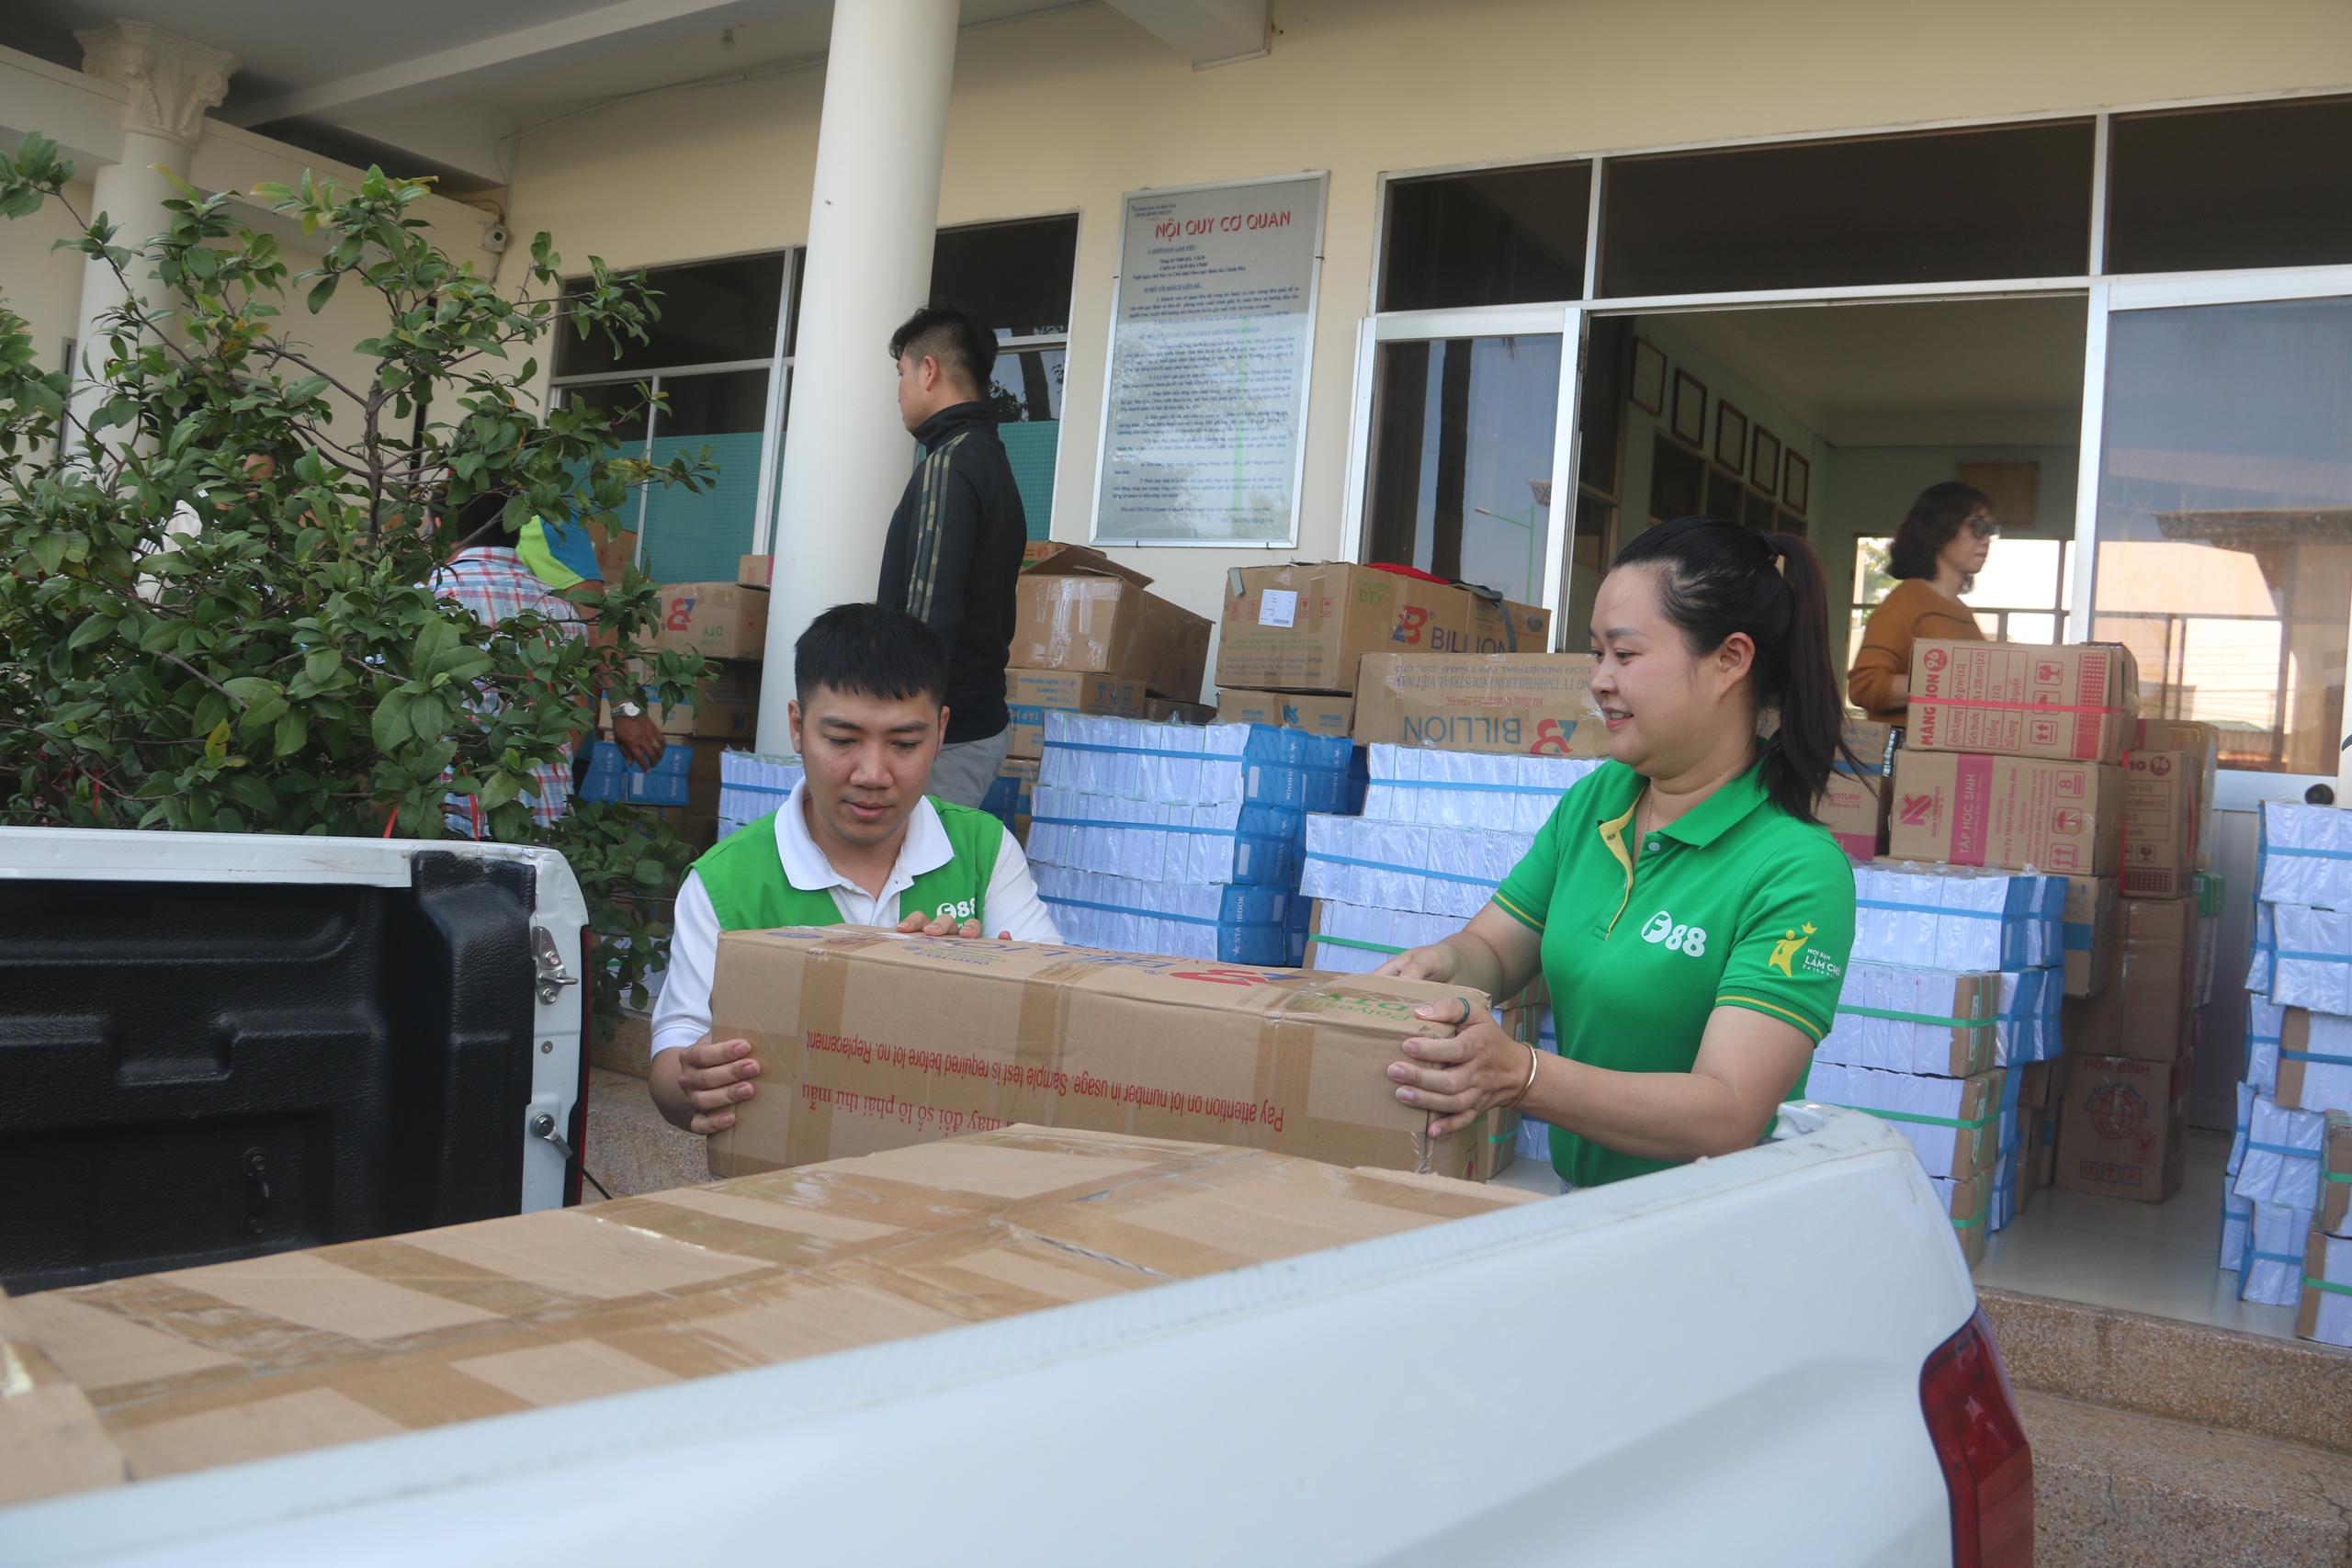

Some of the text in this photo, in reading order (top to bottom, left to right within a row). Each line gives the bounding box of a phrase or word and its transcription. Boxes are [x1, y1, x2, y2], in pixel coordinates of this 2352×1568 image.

[1156, 210, 1291, 242] NỘI QUY CƠ QUAN
[1357, 576, 1392, 592] Polyester
[1358, 589, 1385, 605] DTY
[703, 626, 723, 637] DTY
[1926, 651, 1939, 669] 96
[1414, 673, 1436, 691] VIỆT
[1439, 676, 1493, 688] INDUSTRIAL
[1495, 677, 1532, 689] BILLION
[1534, 678, 1559, 689] TNHH
[1559, 678, 1575, 689] TY
[1973, 679, 1983, 689] 205
[2009, 678, 2021, 696] quyển
[1919, 706, 1936, 746] MĂNG
[1952, 710, 1963, 728] lượng
[1971, 713, 1980, 730] thước
[1404, 716, 1521, 744] BILLION
[1951, 729, 1962, 743] Định
[1986, 720, 2000, 736] trắng
[2007, 721, 2018, 738] lượng
[1969, 731, 1978, 744] Kích
[1987, 738, 1998, 746] Độ
[2005, 739, 2014, 747] Số
[1958, 774, 1975, 853] TẬP HỌC SINH
[2007, 800, 2016, 816] Giấy
[2004, 838, 2012, 846] Ty
[1274, 832, 1285, 878] SARBOOK
[2003, 848, 2011, 865] Công
[1640, 909, 1707, 957] F88
[1807, 948, 1831, 960] NƠI BẠN
[1319, 993, 1408, 1011] DTY
[807, 1031, 1284, 1132] Pay attention on lot number in usage. Sample test is required before lot no. Replacement
[802, 1084, 831, 1110] mẫu
[835, 1090, 858, 1112] thử
[864, 1095, 896, 1119] phải
[899, 1104, 913, 1123] lô
[918, 1105, 934, 1132] số
[939, 1110, 963, 1136] đổi
